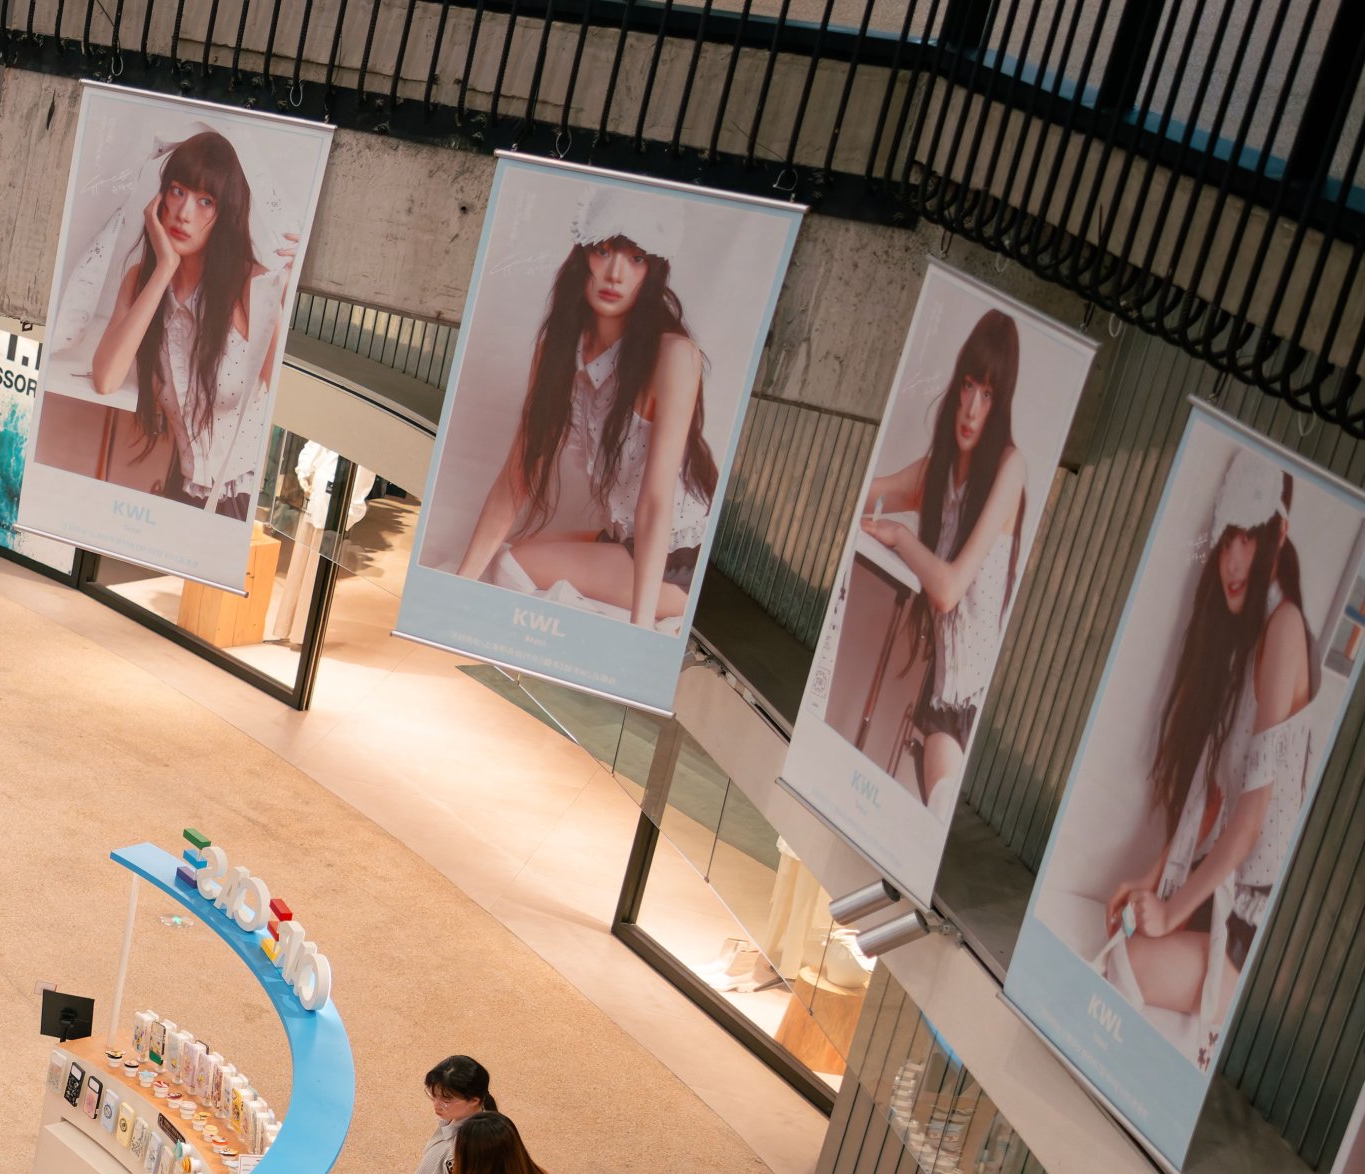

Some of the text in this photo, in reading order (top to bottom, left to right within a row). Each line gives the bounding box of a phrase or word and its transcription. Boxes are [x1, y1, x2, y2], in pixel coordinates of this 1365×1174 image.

[113, 500, 156, 525] KWL
[513, 608, 566, 637] KWL
[851, 770, 880, 808] KWL
[1088, 993, 1123, 1043] KWL
